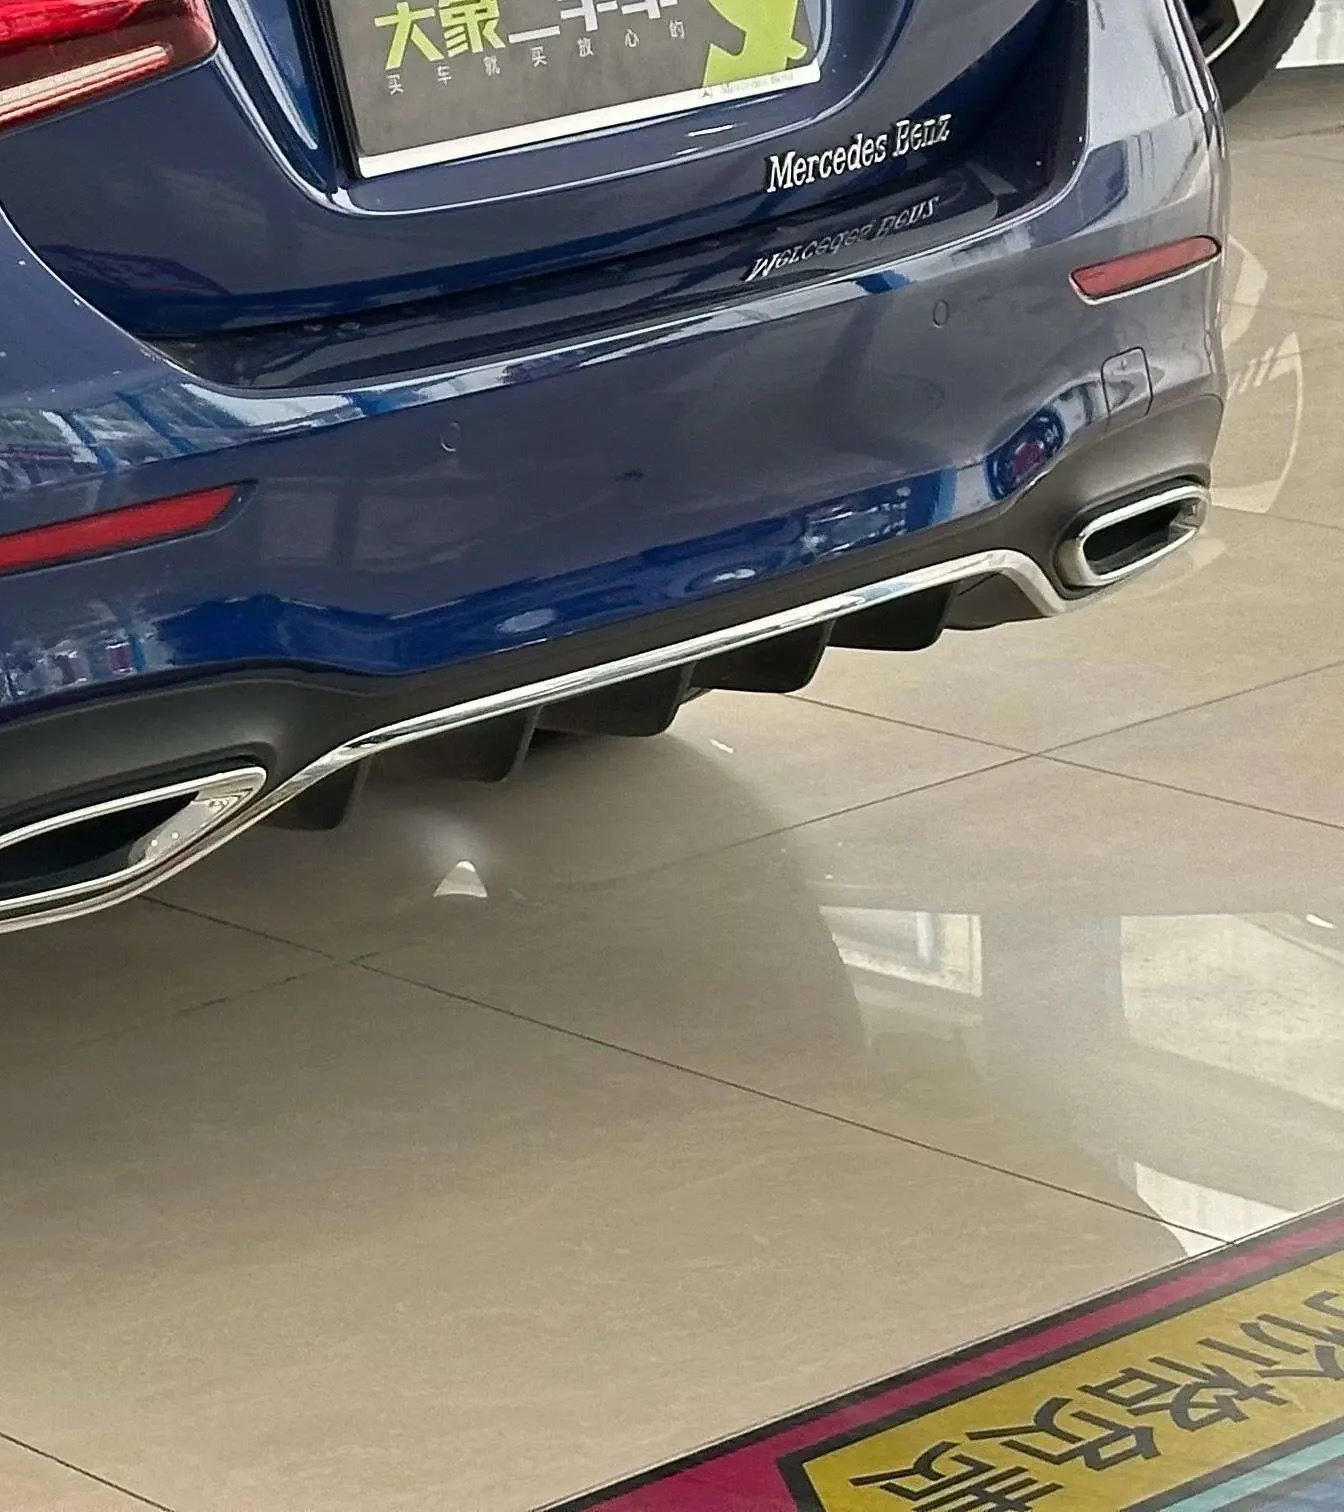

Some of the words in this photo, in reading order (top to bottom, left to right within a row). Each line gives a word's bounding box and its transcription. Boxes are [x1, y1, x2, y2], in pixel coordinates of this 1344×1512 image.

[385, 20, 686, 95] 买车就买放心的
[766, 133, 888, 193] Mercedes
[891, 113, 952, 157] Benz
